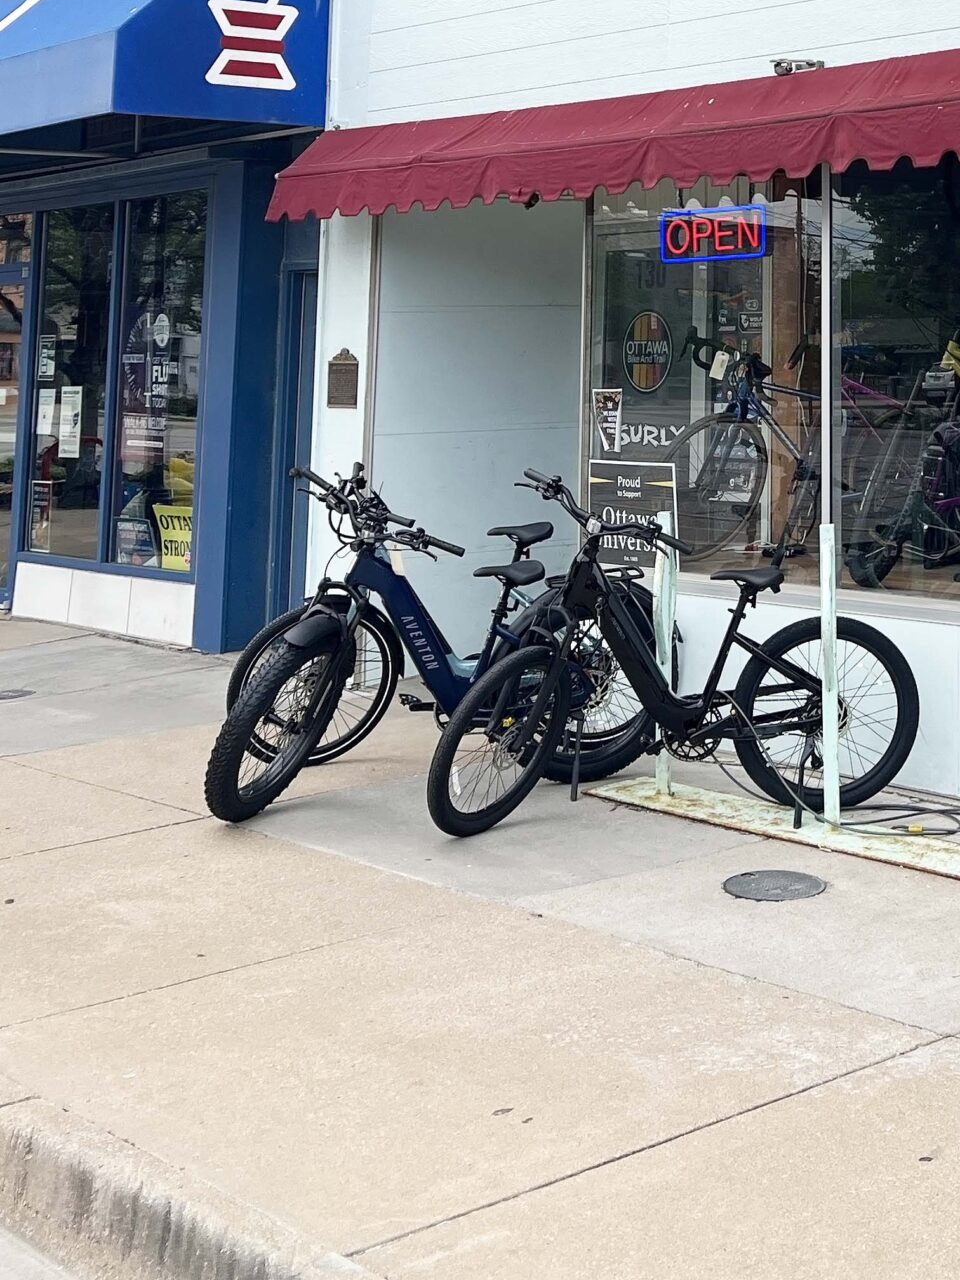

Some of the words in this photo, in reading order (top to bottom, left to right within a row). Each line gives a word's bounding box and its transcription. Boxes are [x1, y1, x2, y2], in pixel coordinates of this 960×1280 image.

[666, 215, 760, 255] OPEN
[626, 340, 669, 355] OTTAWA
[627, 353, 640, 364] Bike
[641, 353, 653, 364] And
[152, 366, 169, 382] FLU
[619, 423, 686, 448] SURLY
[617, 475, 641, 488] Proud
[401, 616, 439, 670] AVENTON
